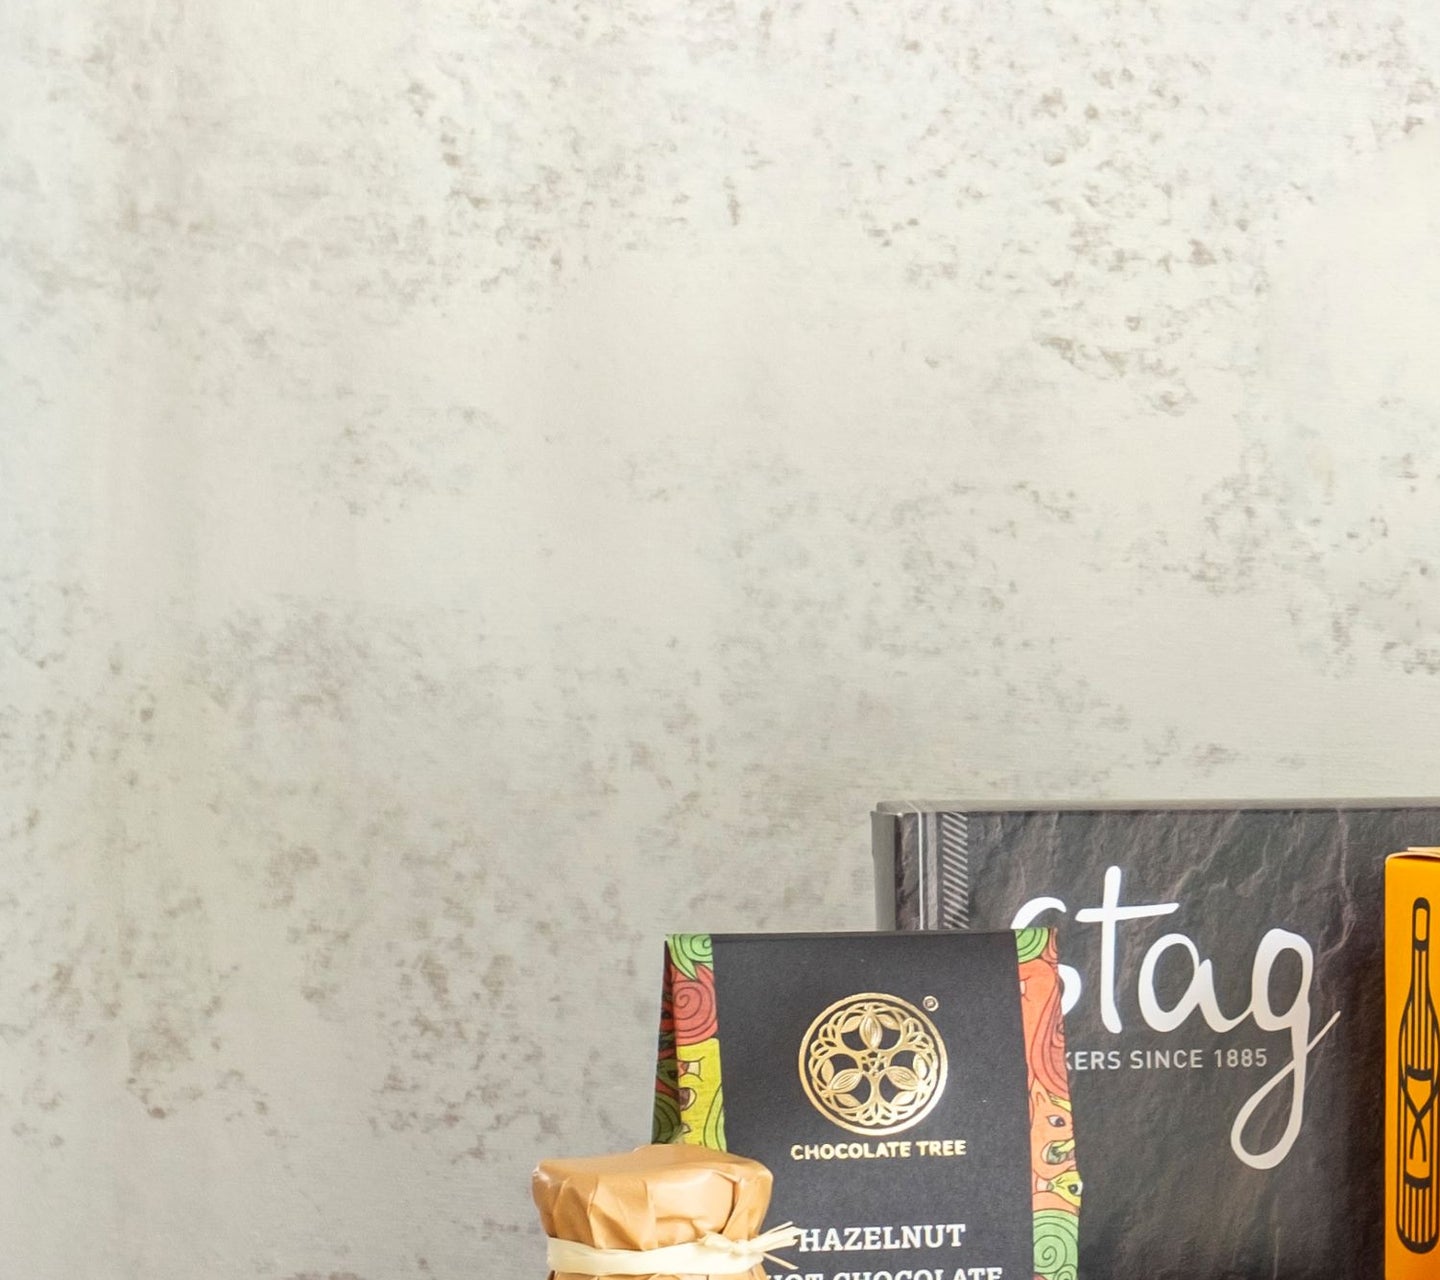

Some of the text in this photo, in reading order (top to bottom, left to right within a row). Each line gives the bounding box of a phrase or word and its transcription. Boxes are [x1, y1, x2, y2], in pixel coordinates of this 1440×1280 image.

[1130, 1049, 1267, 1068] SINCE 1885
[790, 1140, 966, 1160] CHOCOLATE TREE
[799, 1224, 966, 1252] HAZELNUT
